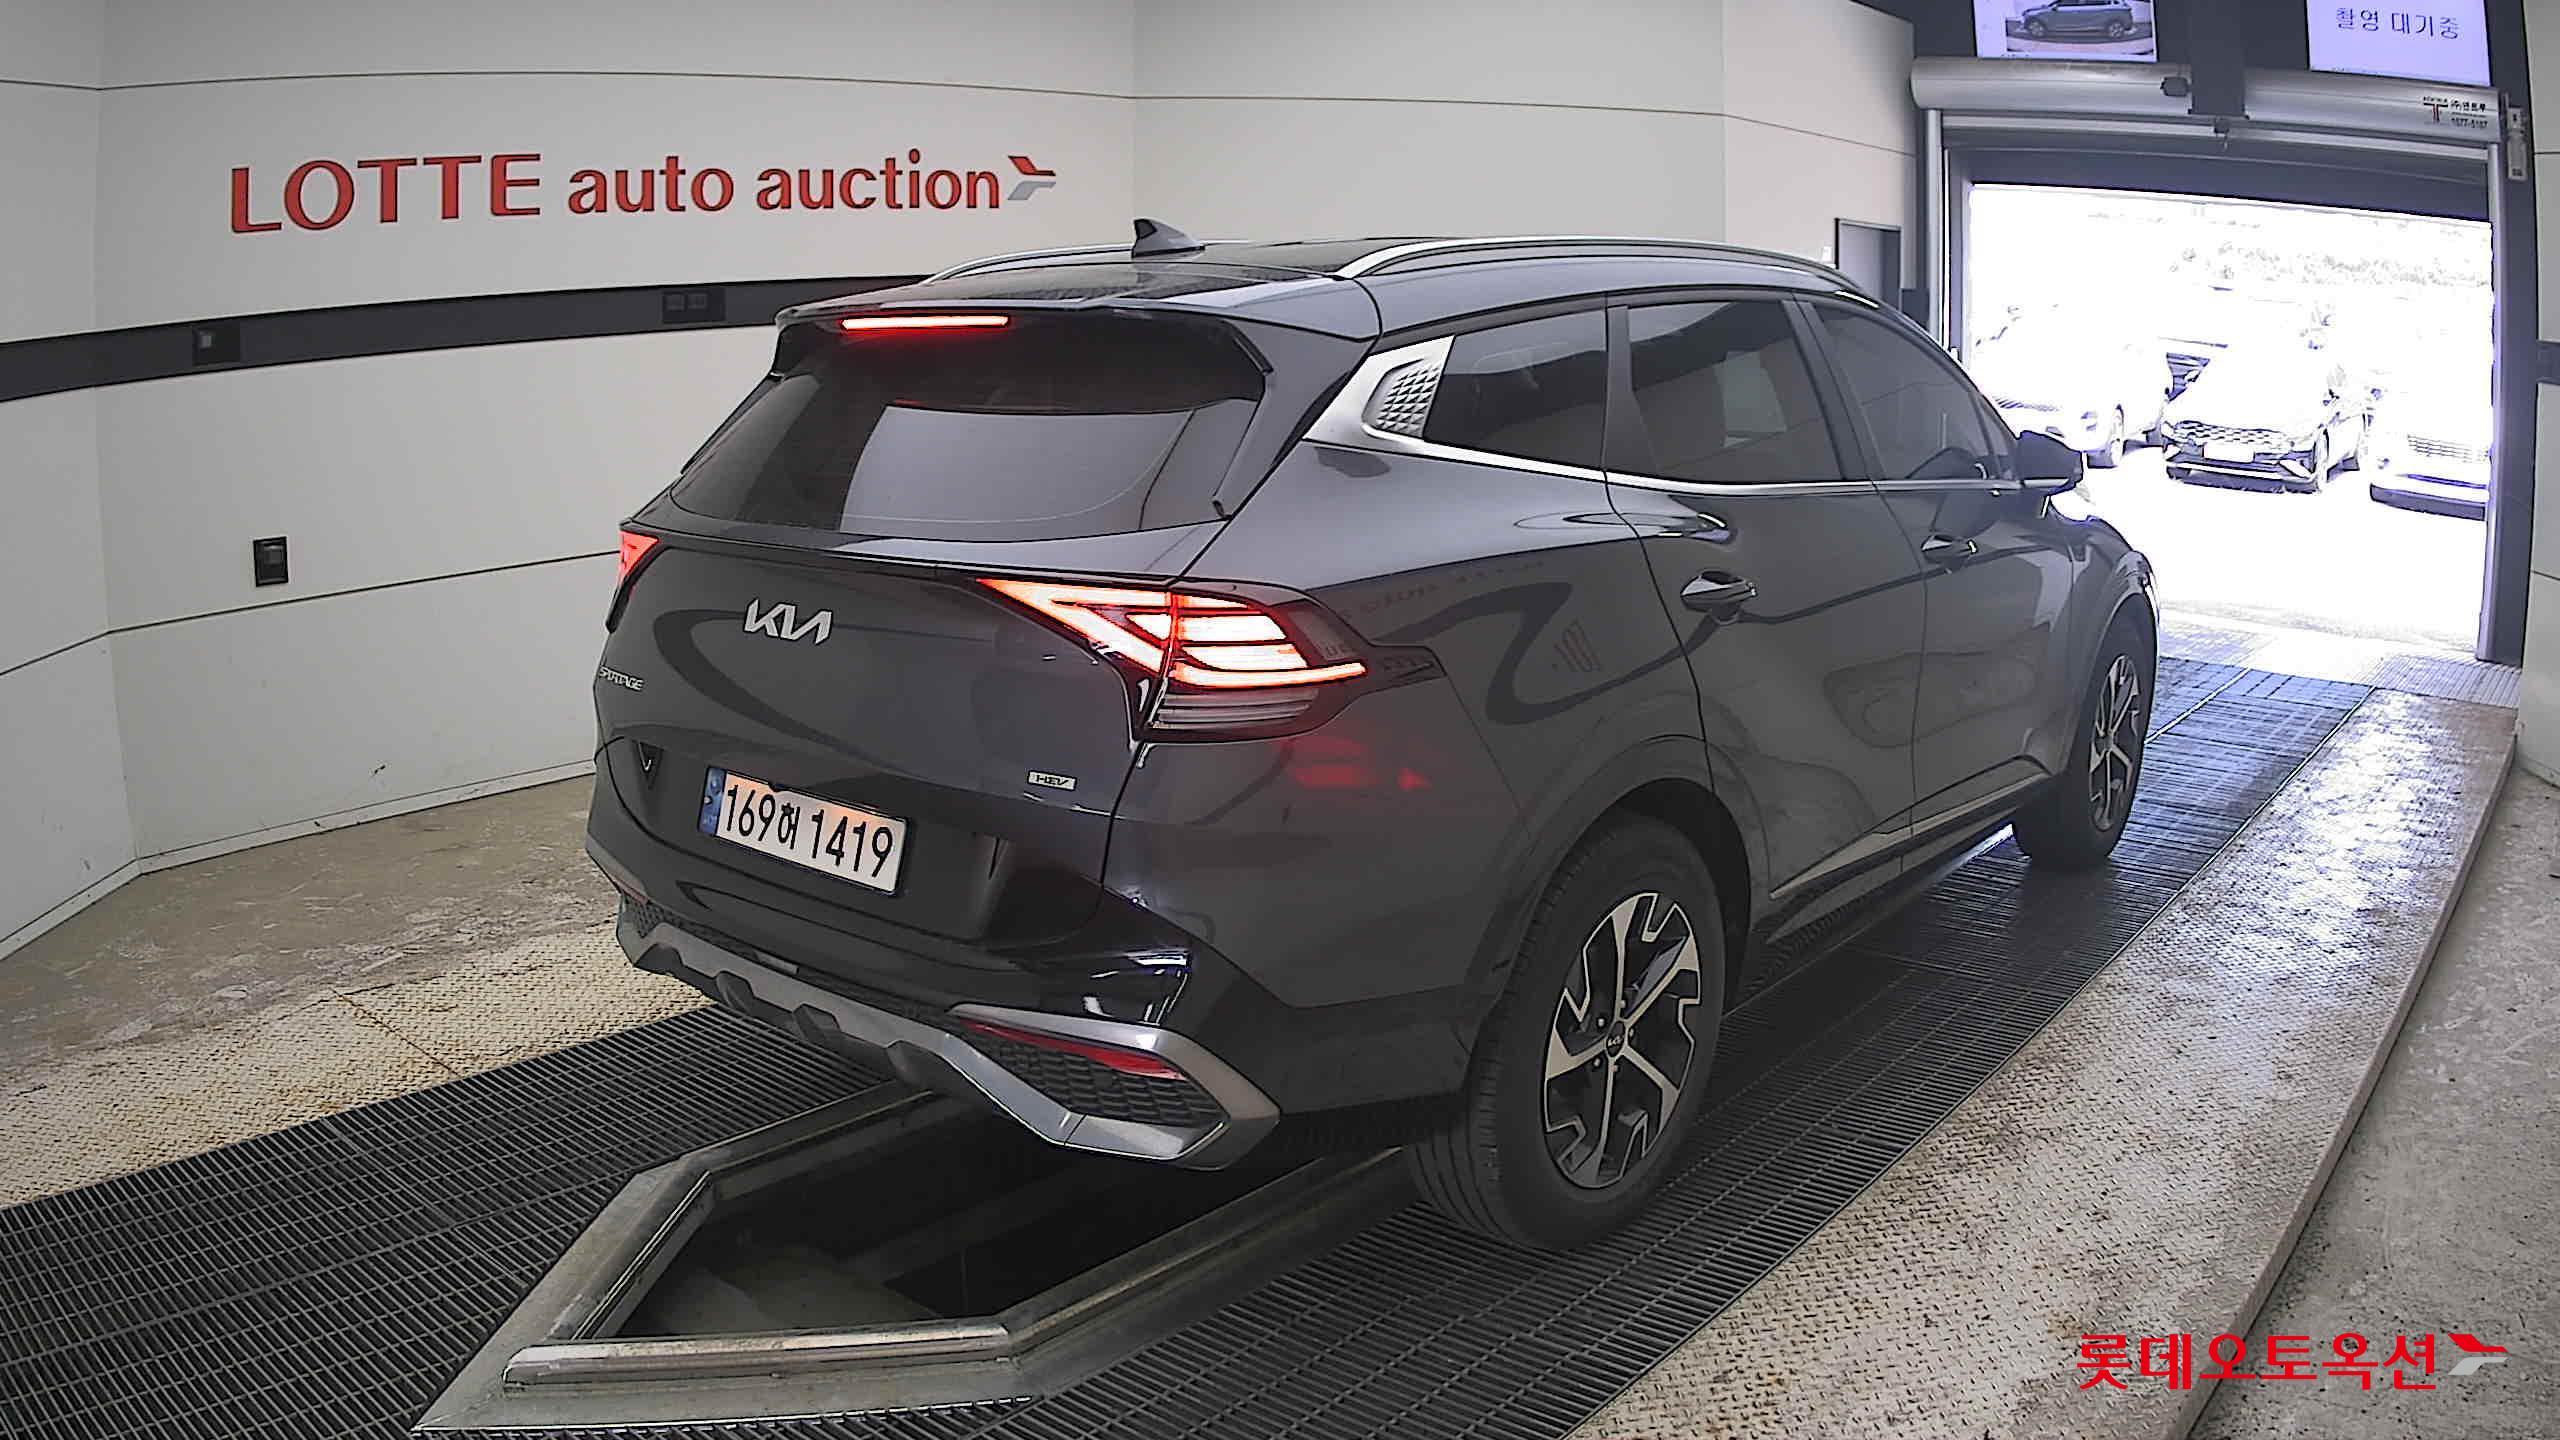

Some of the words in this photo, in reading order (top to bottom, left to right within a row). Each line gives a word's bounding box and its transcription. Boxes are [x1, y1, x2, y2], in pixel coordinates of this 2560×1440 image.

[2336, 7, 2379, 32] 촬영
[230, 152, 542, 234] LOTTE
[567, 154, 736, 214] auto
[756, 148, 1001, 210] auction
[742, 599, 833, 645] KIA
[1035, 773, 1070, 787] HEV
[726, 784, 801, 850] 169허
[811, 808, 894, 878] 1419
